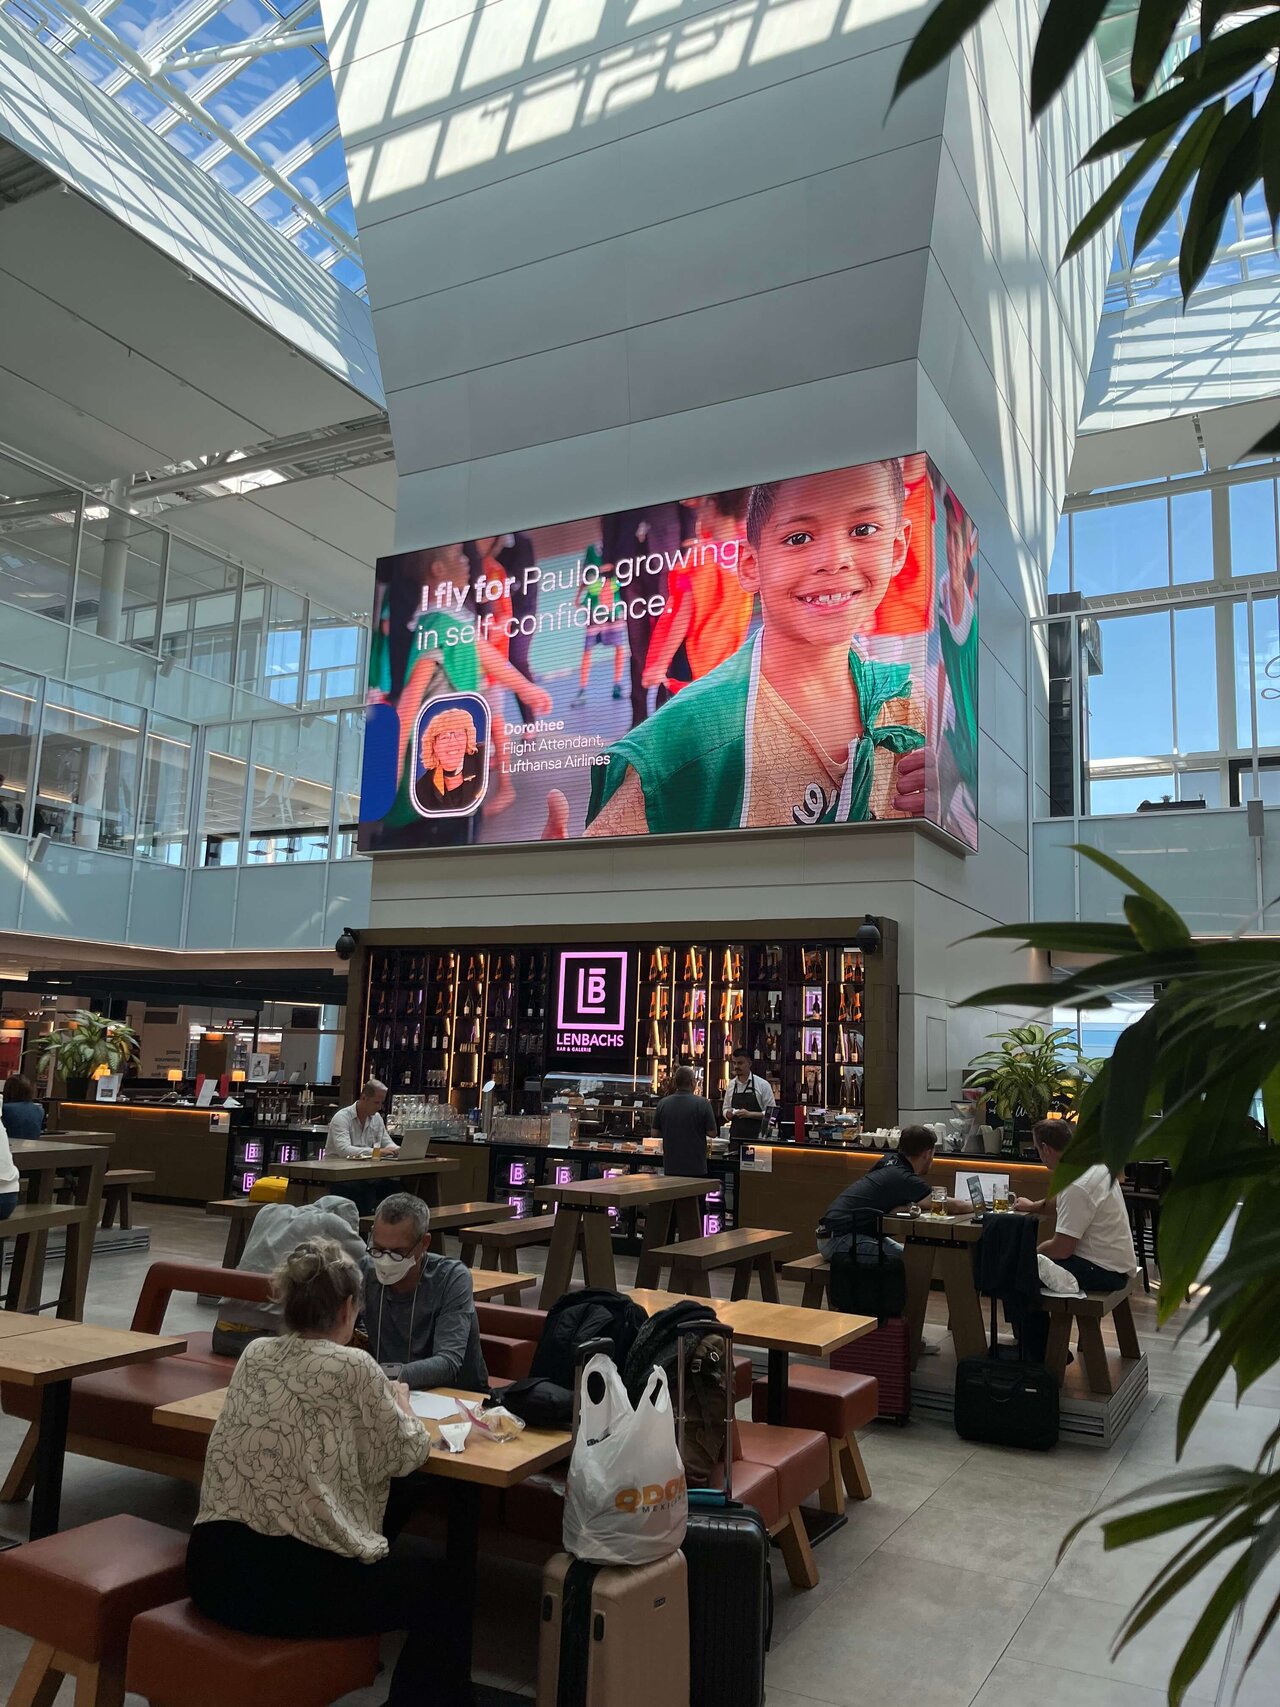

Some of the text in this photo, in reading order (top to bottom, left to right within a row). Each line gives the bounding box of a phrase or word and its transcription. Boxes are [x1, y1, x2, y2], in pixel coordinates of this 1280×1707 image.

[421, 538, 740, 613] I fly for Paulo, growing
[416, 594, 673, 651] in self-confidence.
[503, 719, 565, 736] Dorothee
[502, 734, 605, 757] Flight Attendant,
[501, 753, 612, 774] Lufthansa Airlines
[556, 1033, 624, 1047] LENBACHS
